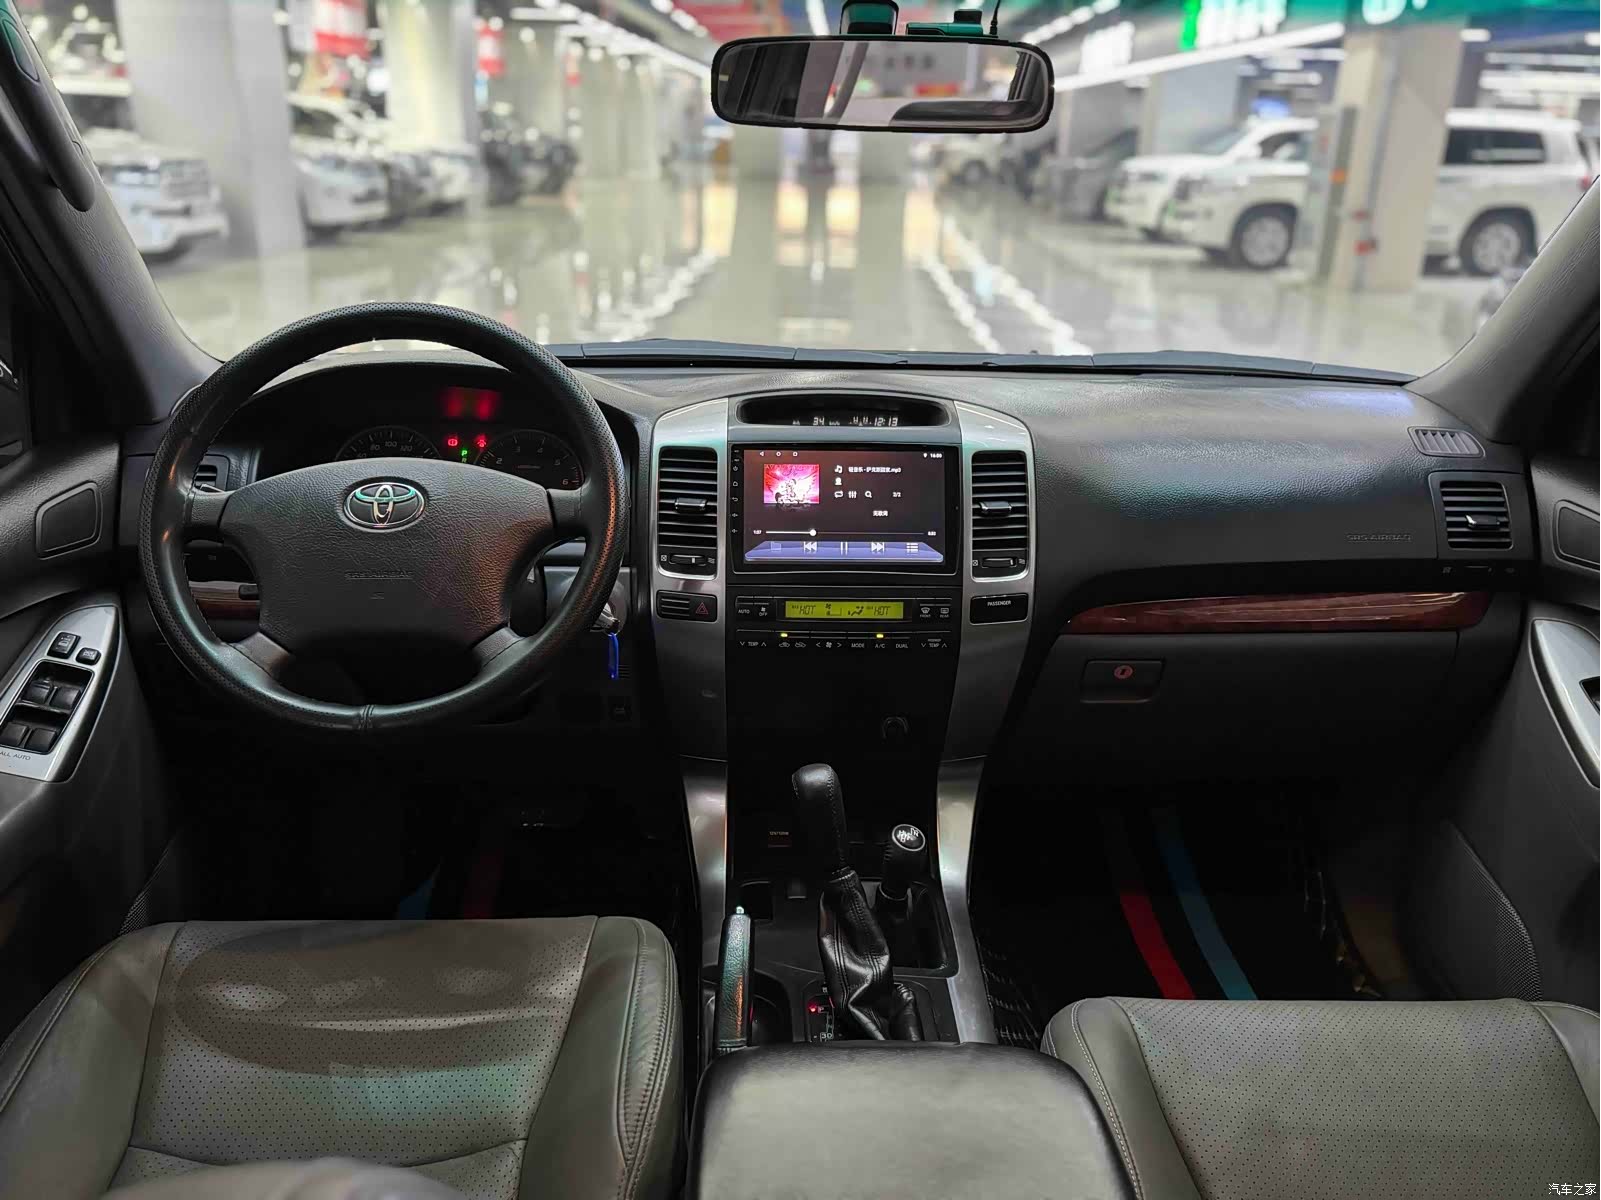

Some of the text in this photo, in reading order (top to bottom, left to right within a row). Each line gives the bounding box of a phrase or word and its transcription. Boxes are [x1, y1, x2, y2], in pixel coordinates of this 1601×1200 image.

[812, 416, 825, 426] 34
[873, 416, 899, 427] 12:13
[13, 753, 31, 761] AUTO
